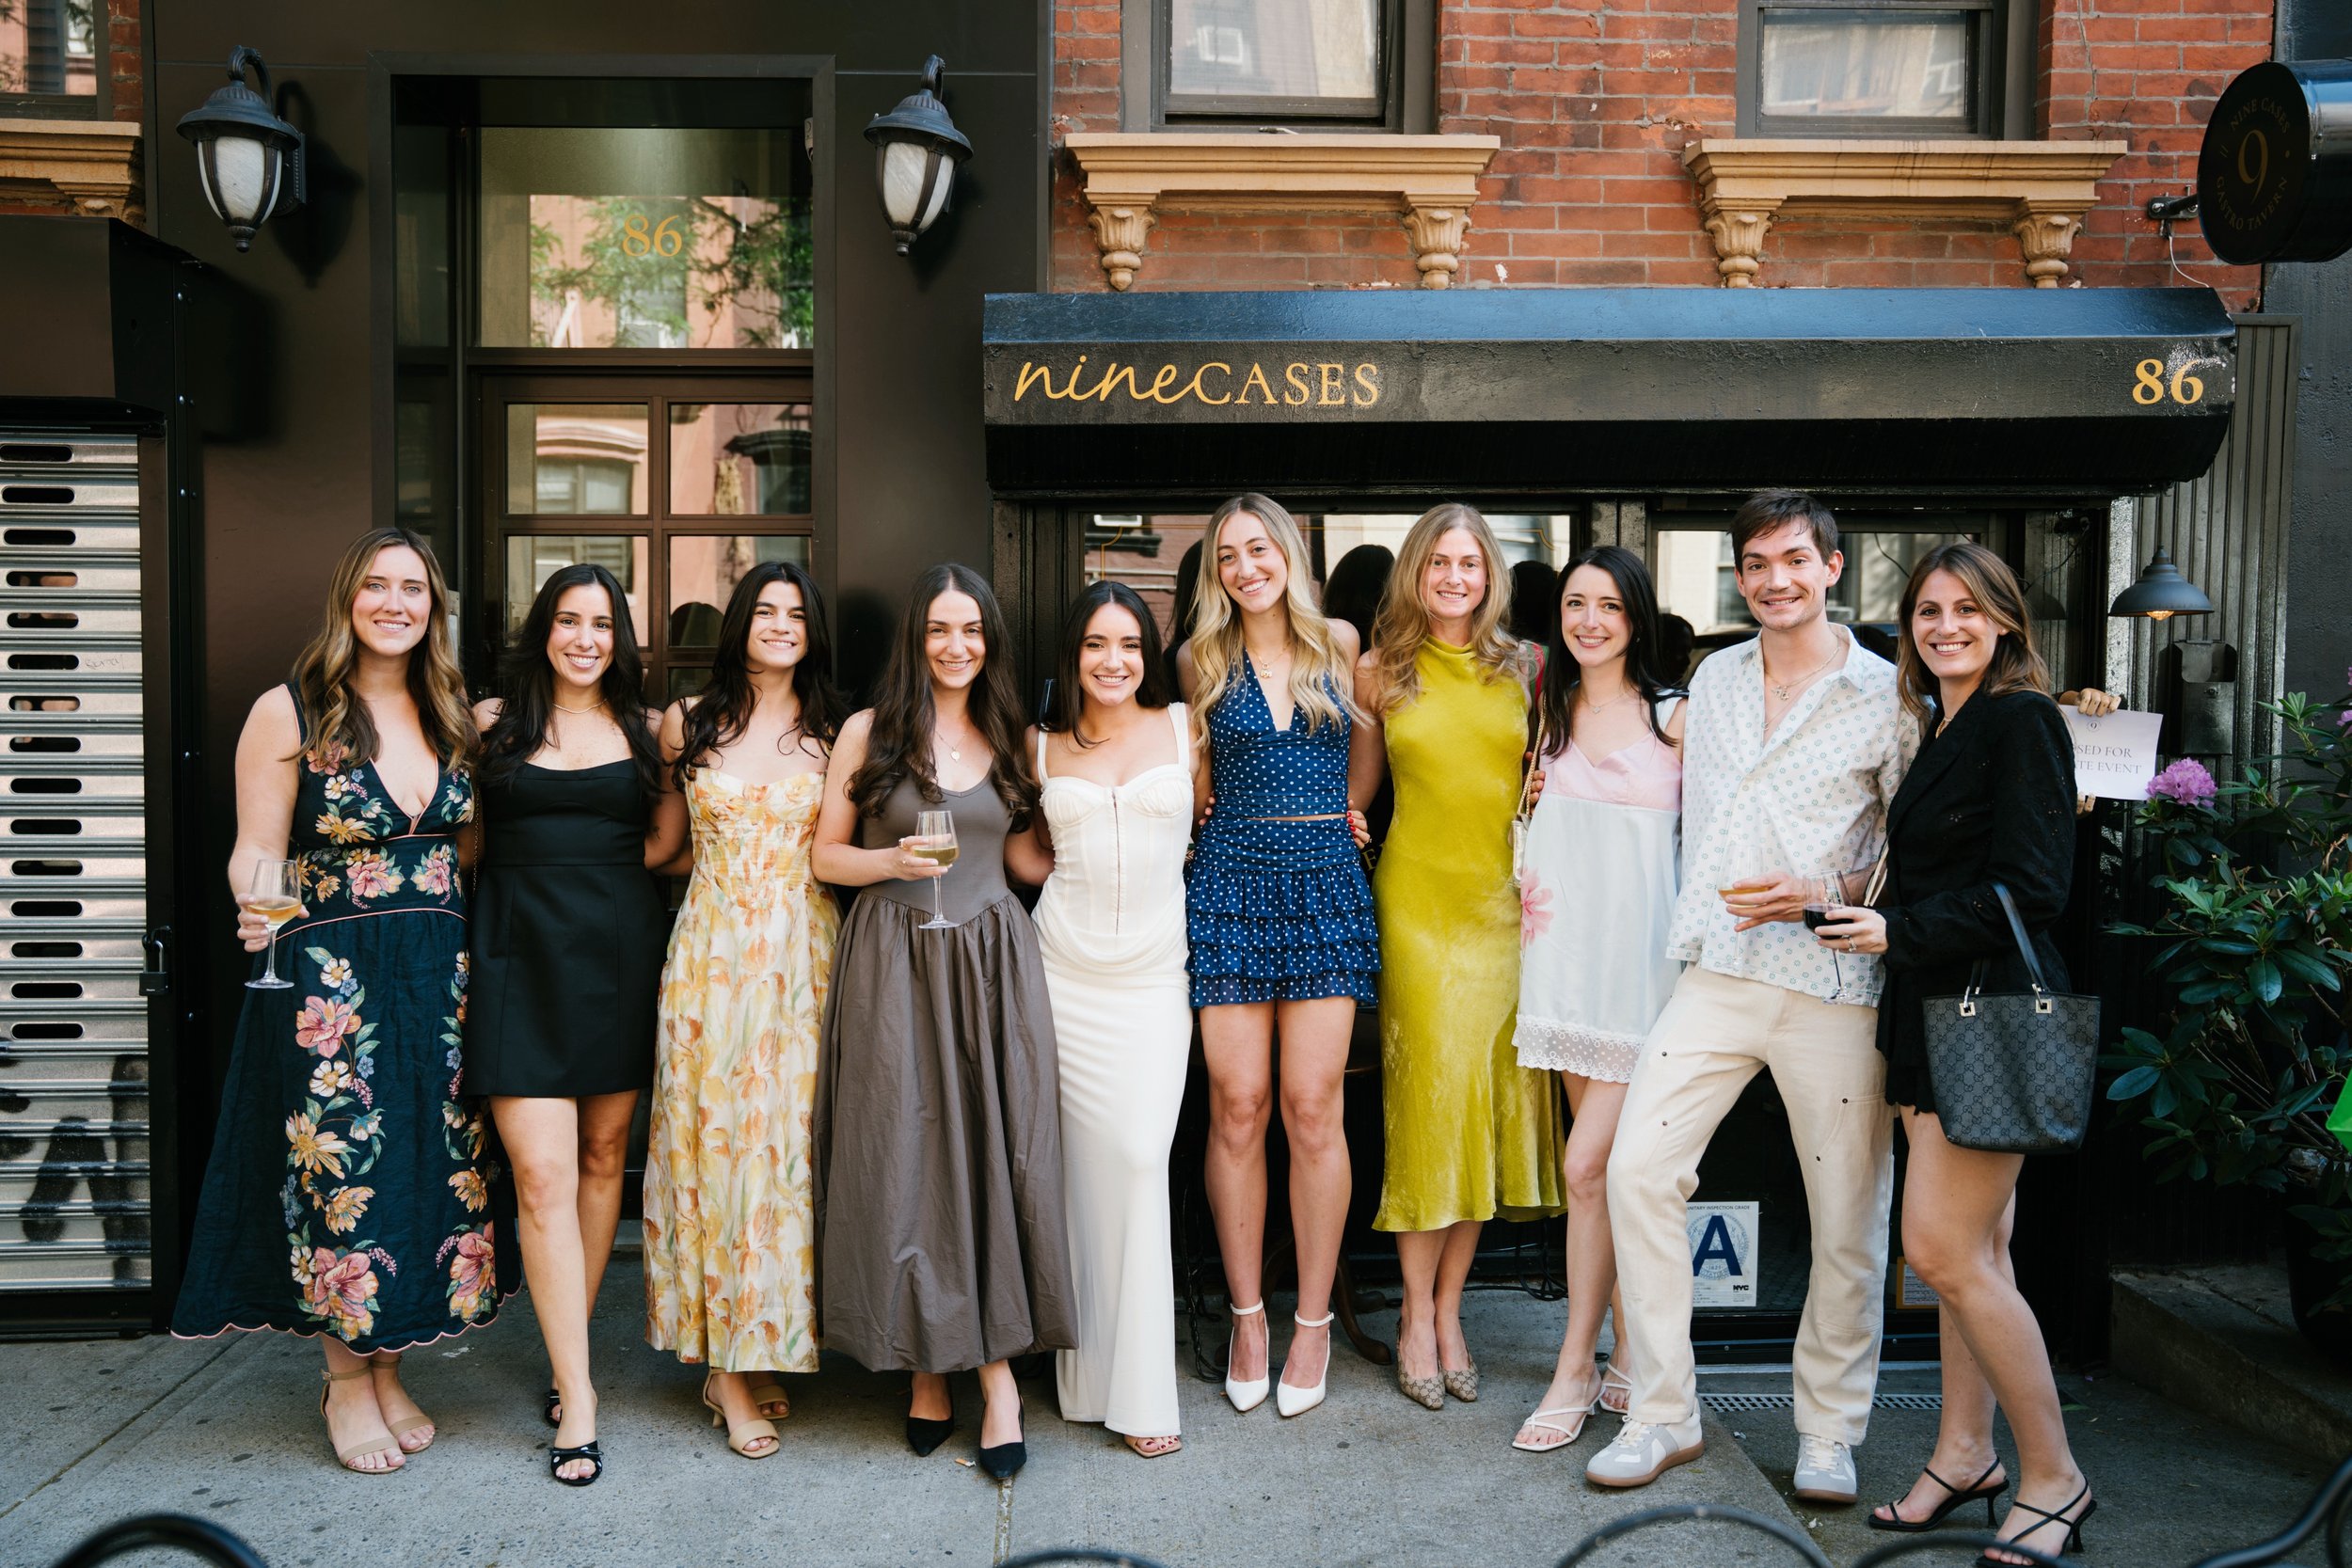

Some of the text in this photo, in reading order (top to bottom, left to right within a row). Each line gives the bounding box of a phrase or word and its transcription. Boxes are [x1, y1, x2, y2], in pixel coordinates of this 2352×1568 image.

[2231, 96, 2291, 135] NINE CASES
[2237, 128, 2269, 205] 9
[2216, 175, 2289, 231] GASTRO TAVERN
[623, 214, 682, 257] 86
[2132, 358, 2204, 405] 86
[2074, 744, 2132, 758] SED FOR
[2098, 761, 2141, 774] EVENT
[1692, 1215, 1742, 1276] A
